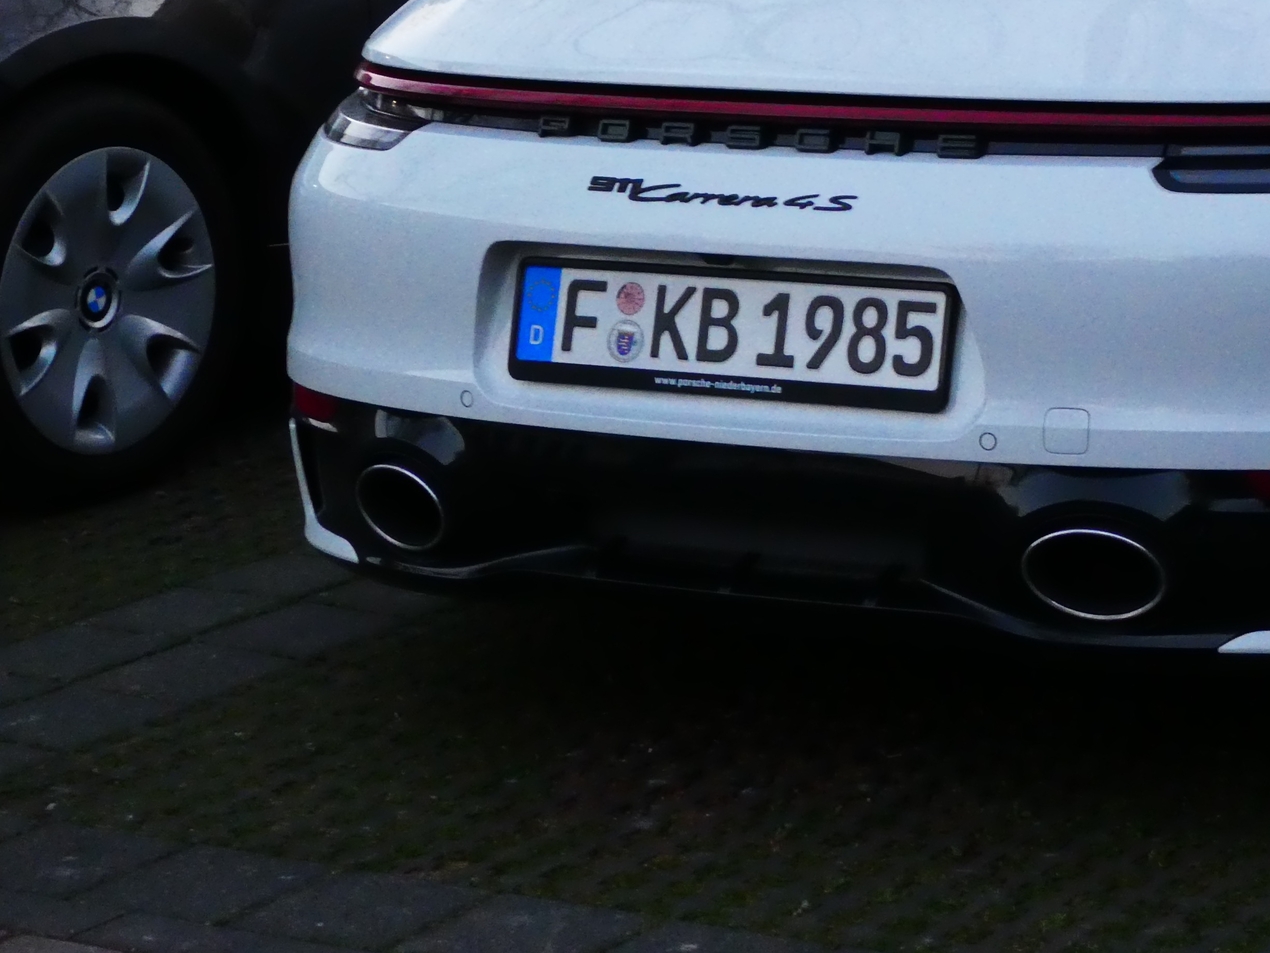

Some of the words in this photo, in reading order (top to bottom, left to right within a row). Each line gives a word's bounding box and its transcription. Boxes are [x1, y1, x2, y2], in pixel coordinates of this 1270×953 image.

[537, 115, 981, 160] PORSCHE
[629, 184, 778, 208] Carrera
[530, 326, 543, 345] D
[561, 279, 608, 352] F
[650, 284, 740, 363] KB
[756, 292, 937, 378] 1985
